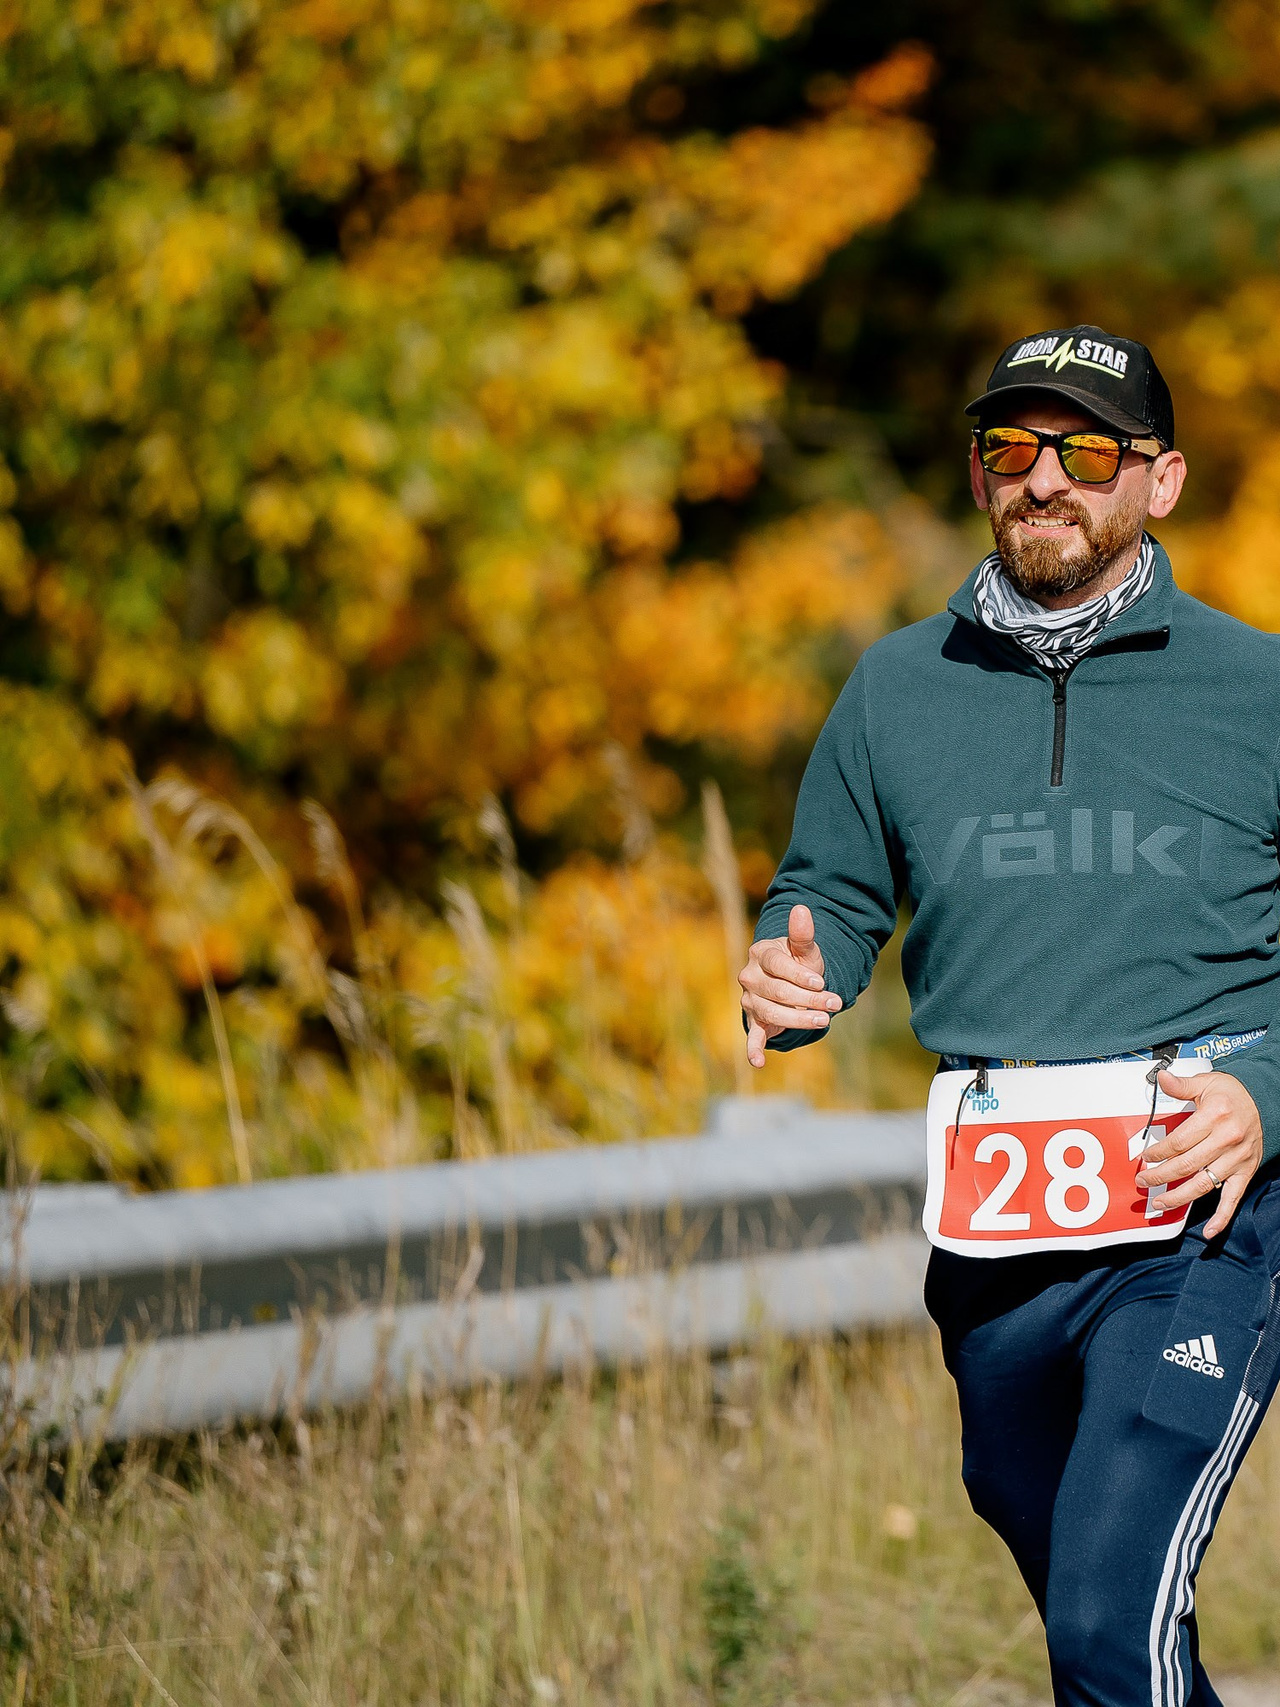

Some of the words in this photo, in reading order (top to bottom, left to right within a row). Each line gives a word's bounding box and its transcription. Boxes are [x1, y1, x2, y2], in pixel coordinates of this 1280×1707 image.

[1012, 336, 1060, 361] IRON
[1076, 339, 1129, 374] STAR
[1162, 1348, 1225, 1379] adidas
